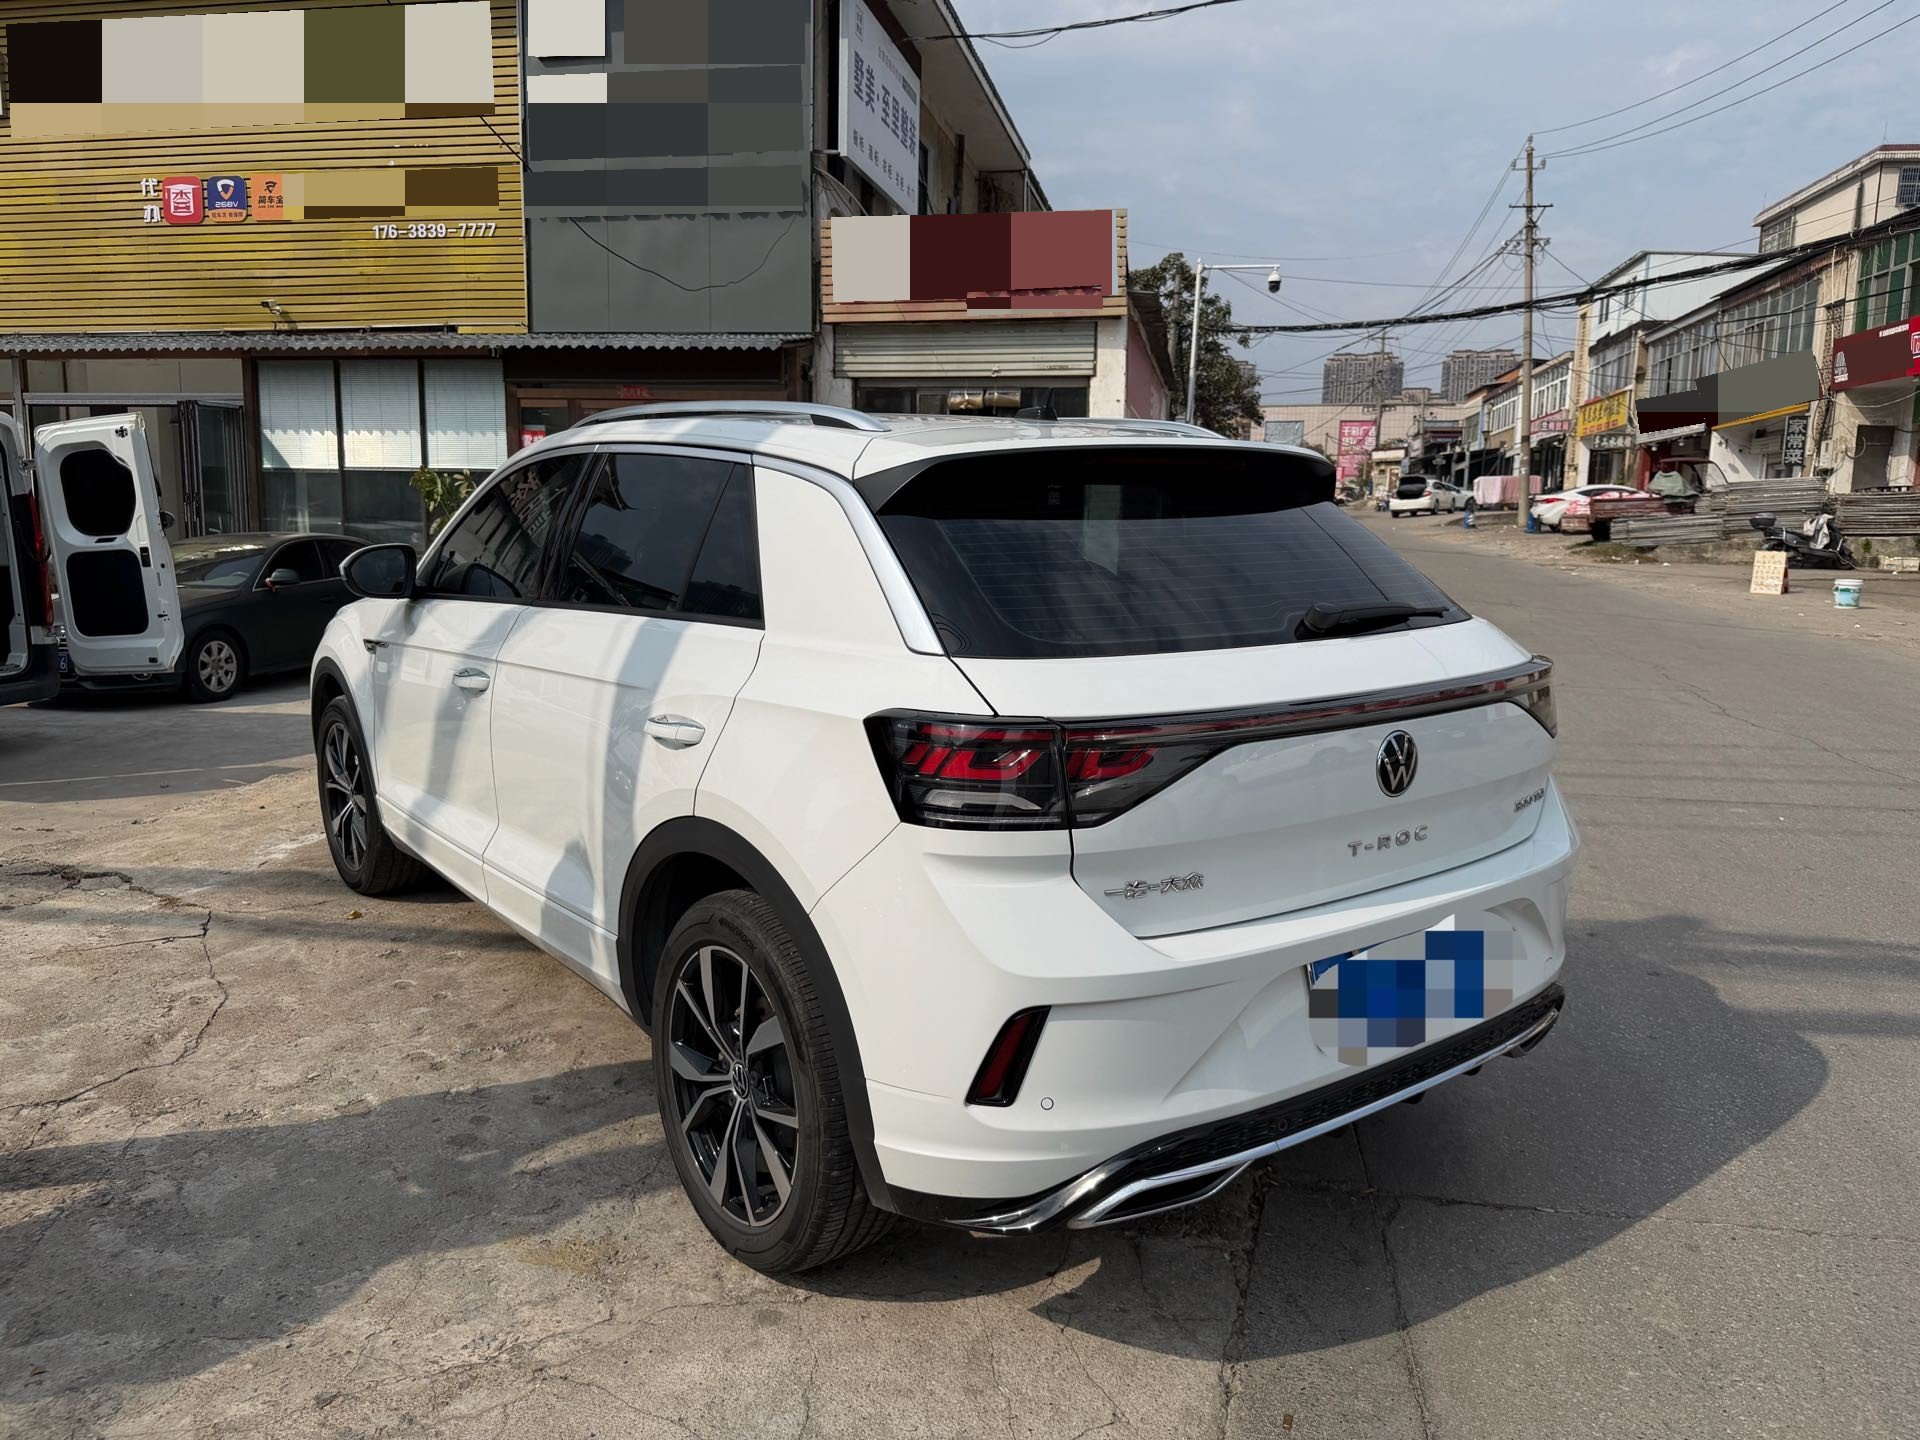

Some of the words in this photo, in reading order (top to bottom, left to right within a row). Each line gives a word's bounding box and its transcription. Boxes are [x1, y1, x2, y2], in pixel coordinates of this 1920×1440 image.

[140, 178, 161, 223] 代办
[215, 200, 239, 208] 268V
[372, 222, 497, 240] 176-3839-7777
[1784, 418, 1807, 464] 家常菜
[1347, 825, 1429, 857] T-ROC
